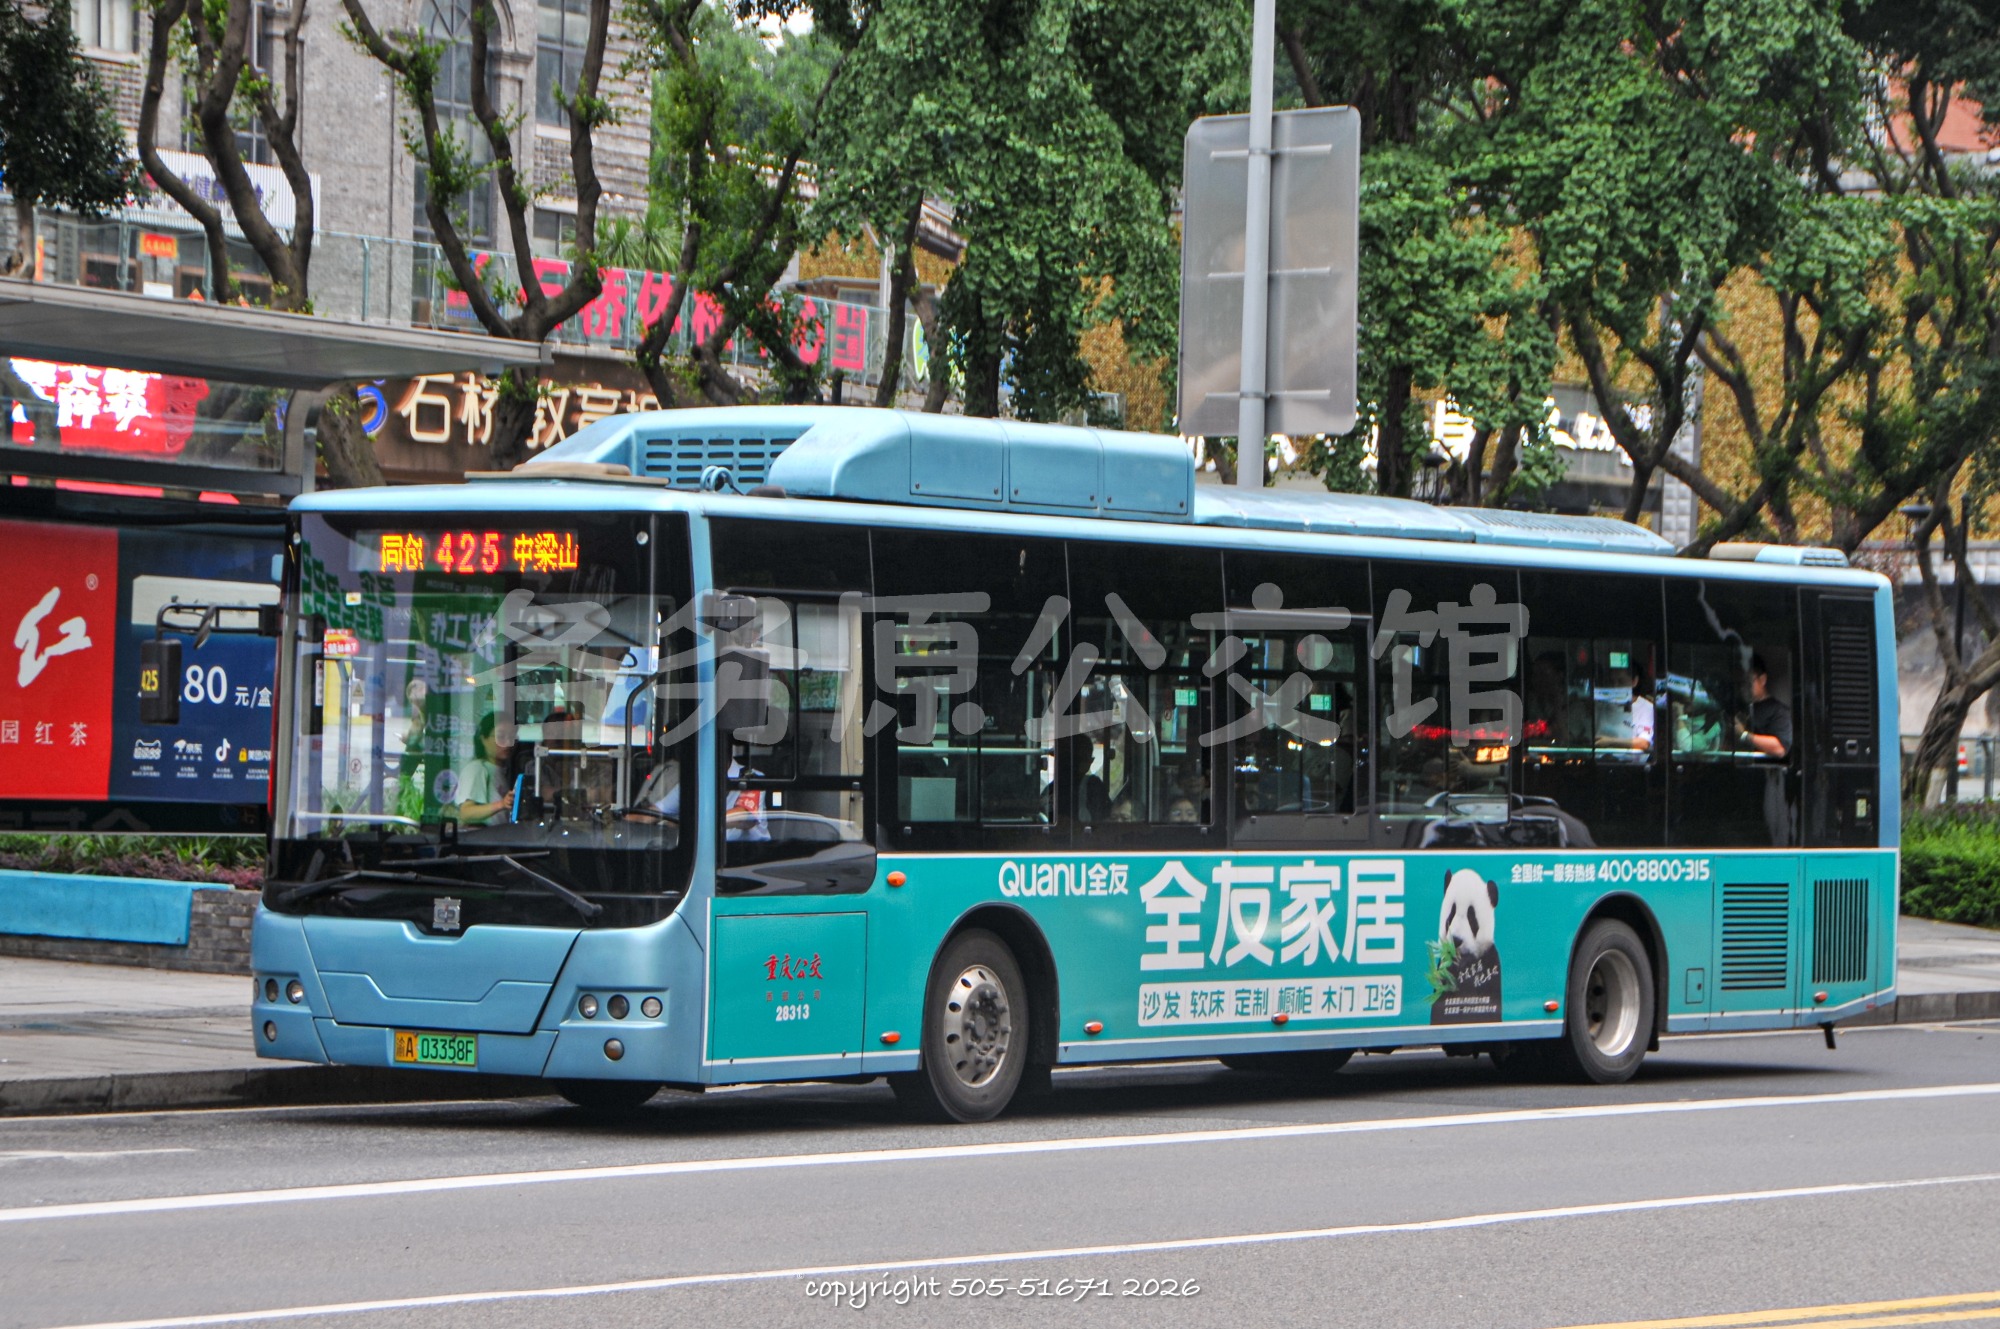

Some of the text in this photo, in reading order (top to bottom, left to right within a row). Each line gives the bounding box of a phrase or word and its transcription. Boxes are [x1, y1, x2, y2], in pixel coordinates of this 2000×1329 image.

[436, 532, 501, 573] 425
[513, 532, 579, 573] 中梁山
[1, 720, 88, 746] 园红茶
[1511, 859, 1710, 883] 全国统一服务热线 400-8800-315
[1139, 859, 1405, 971] 全友家居
[763, 952, 824, 981] 重庆公交
[776, 1004, 810, 1021] 28313
[1142, 983, 1396, 1021] 沙发 软床 定制 橱柜 木门 卫浴
[421, 1037, 474, 1061] 03358F
